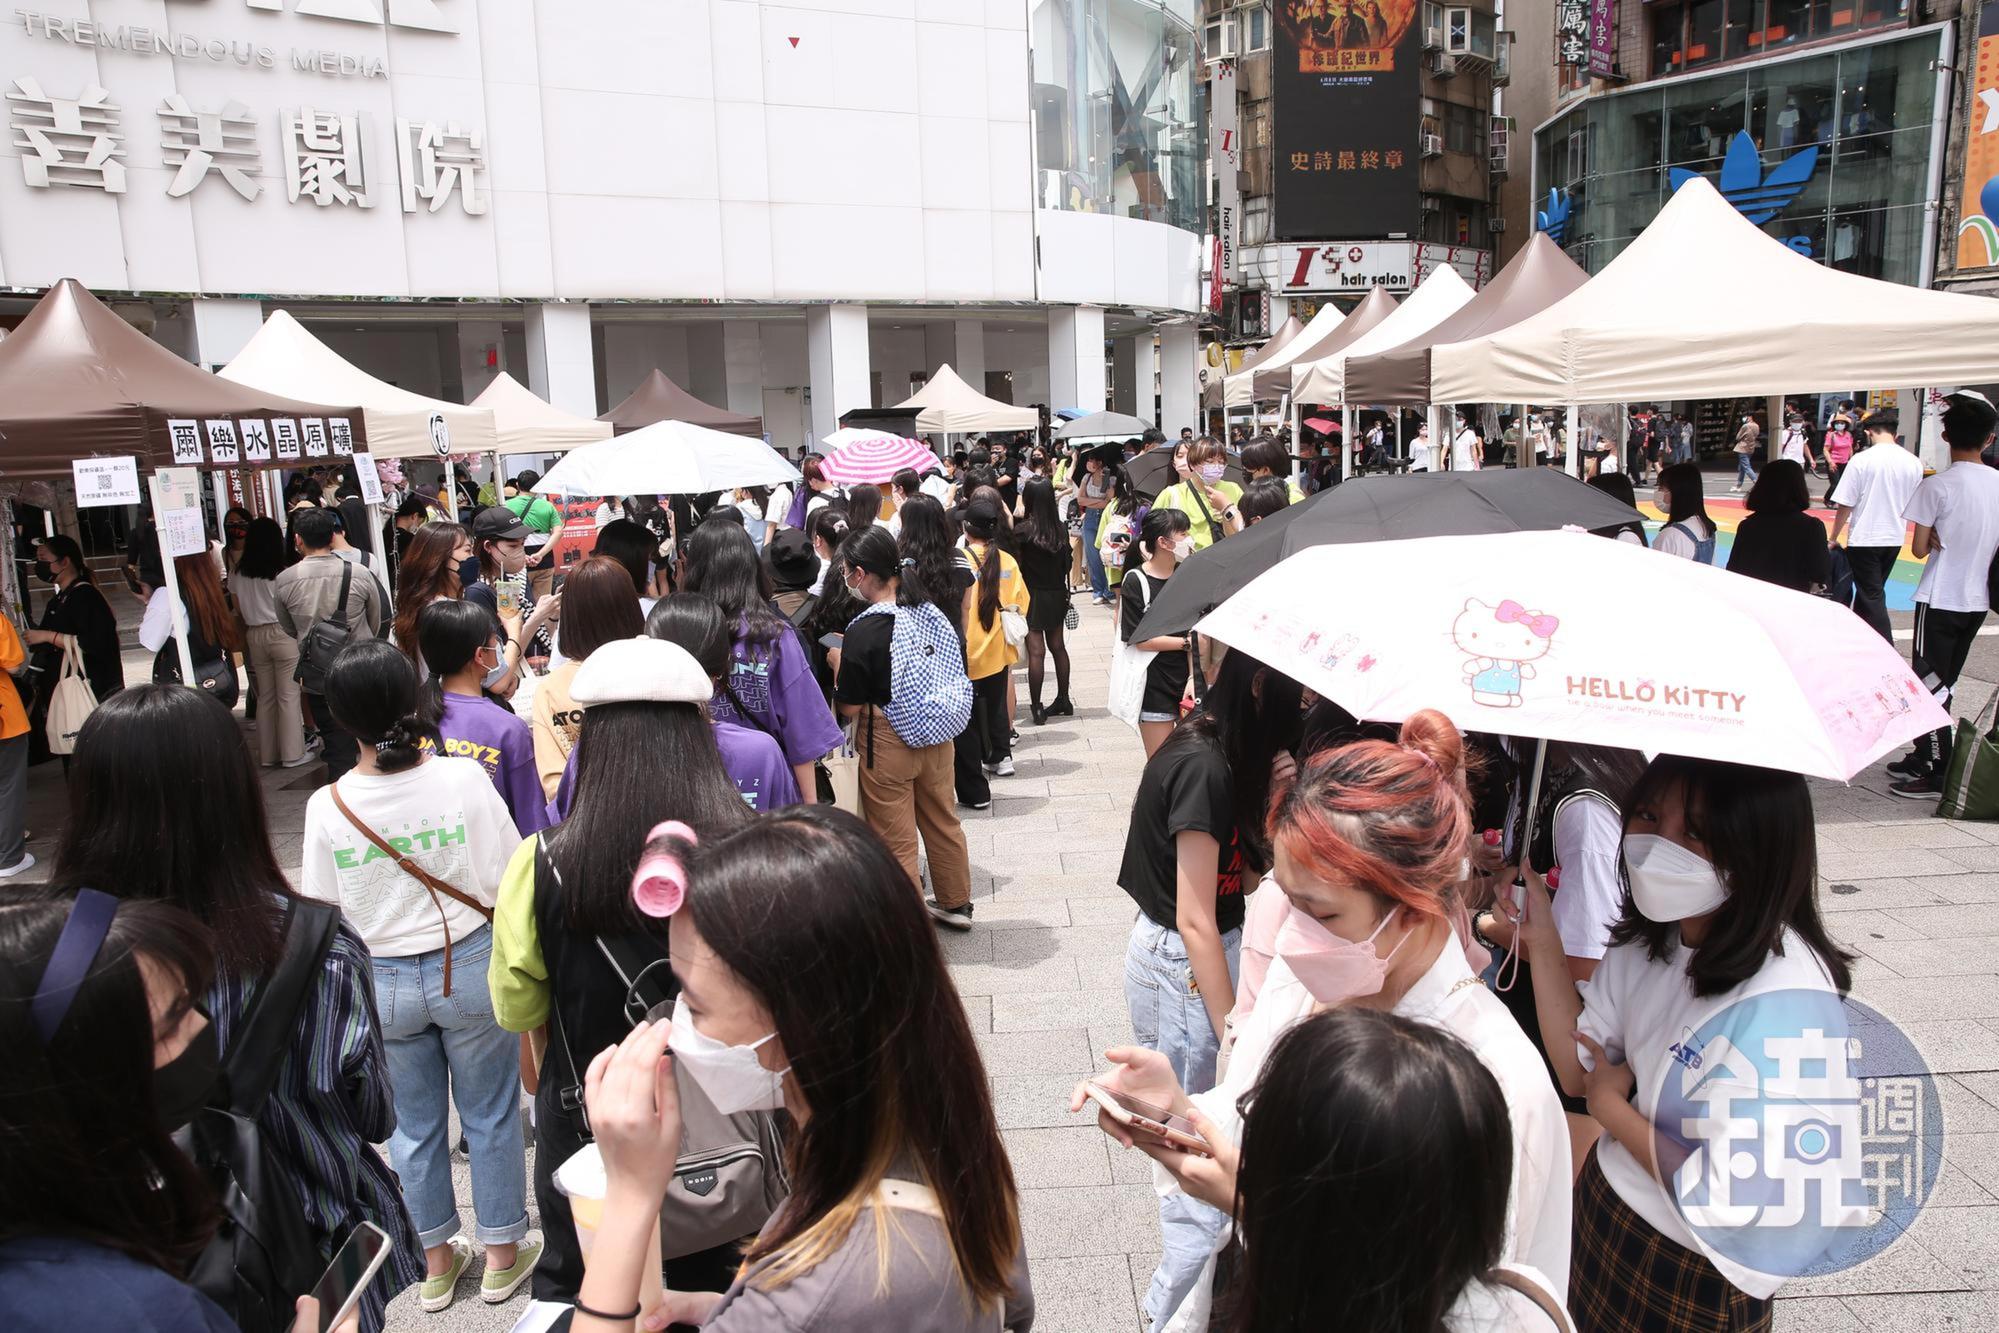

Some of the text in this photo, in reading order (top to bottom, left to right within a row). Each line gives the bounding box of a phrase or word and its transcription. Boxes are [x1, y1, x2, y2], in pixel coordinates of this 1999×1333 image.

[14, 8, 277, 69] TREMENDOUS
[292, 47, 391, 80] MEDIA
[5, 75, 487, 215] 善美劇院
[1290, 150, 1405, 171] 史詩最終章
[1224, 207, 1232, 269] hair salon
[1341, 273, 1406, 285] hair salon
[173, 423, 353, 458] 爾樂水晶原礦
[1566, 676, 1655, 703] HELLO
[1618, 704, 1644, 713] when
[1648, 708, 1665, 717] you
[1668, 711, 1695, 720] meet
[1699, 714, 1745, 727] someone
[445, 738, 500, 765] BOYZ
[334, 824, 466, 869] EARTH
